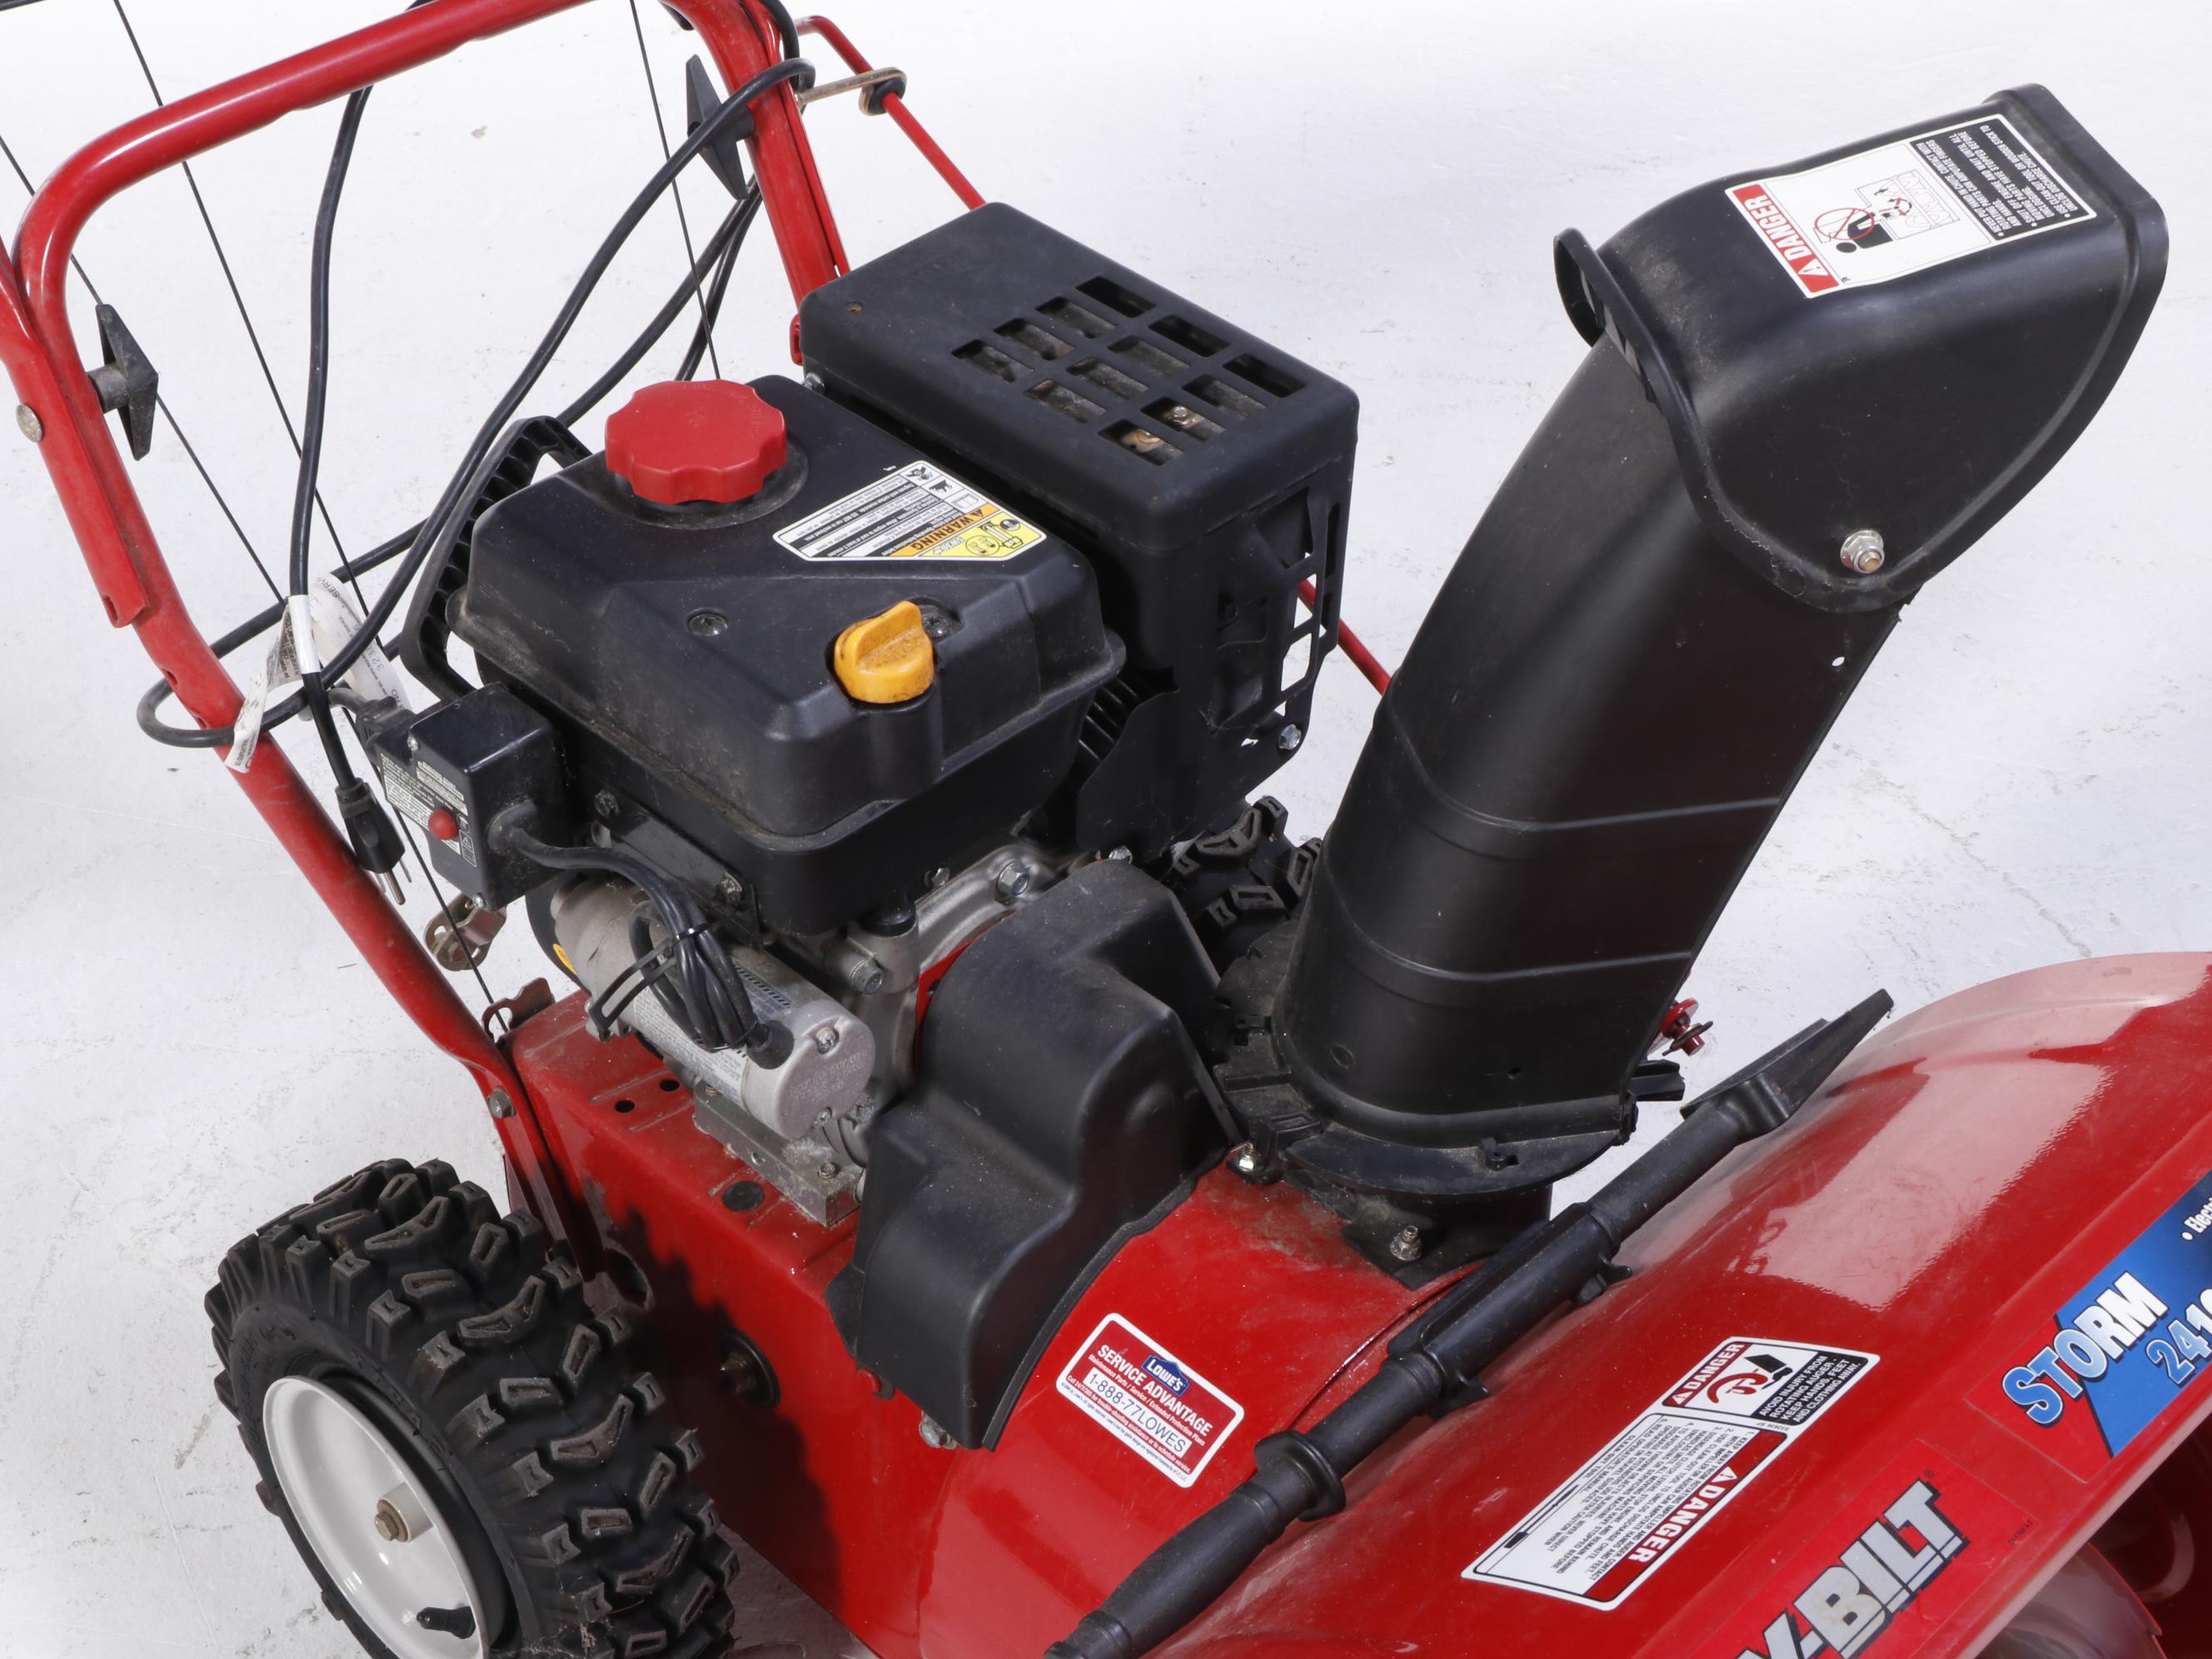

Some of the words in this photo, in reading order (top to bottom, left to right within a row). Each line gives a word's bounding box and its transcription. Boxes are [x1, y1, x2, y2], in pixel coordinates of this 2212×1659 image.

[1977, 124, 1992, 132] TO
[1946, 132, 1963, 143] ALL
[1955, 131, 1980, 150] BEFORE
[1984, 131, 2005, 145] STICK
[1914, 142, 1933, 155] WITH
[1923, 139, 1949, 159] FINGERS
[1955, 142, 1975, 157] UNTIL
[1995, 143, 2021, 163] WOODEN
[1925, 153, 1950, 174] CONTACT
[1968, 157, 1988, 171] WAIT
[1972, 148, 2000, 172] STOPPED
[2012, 161, 2028, 170] OR
[1940, 157, 1970, 182] AMPUTATE
[1980, 169, 1997, 181] AND
[1992, 169, 2013, 184] HAVE
[2020, 168, 2038, 181] TOOL
[1942, 172, 1964, 190] CHUTE.
[1961, 180, 1979, 192] CAN
[1989, 179, 2014, 199] ENGINE
[2030, 167, 2061, 193] DISCHARGE
[1961, 193, 1981, 208] HAND
[1970, 190, 1992, 207] PARTS
[2005, 182, 2028, 201] PARTS
[1989, 197, 2013, 217] HANDS.
[2005, 197, 2024, 209] OFF
[2019, 198, 2046, 220] MOVING
[2052, 203, 2069, 214] USE
[2053, 192, 2079, 212] UNCLOG
[1973, 207, 1990, 217] PUT
[1984, 205, 2014, 230] ROTATING
[2005, 215, 2023, 227] AND
[2015, 207, 2036, 223] SHUT
[1742, 194, 1813, 261] DANGER
[1981, 216, 2003, 232] NEVER
[909, 516, 974, 551] WARNING
[2002, 1271, 2169, 1427] STORM
[1145, 1358, 1184, 1392] LOWE'S
[1681, 1343, 1745, 1389] DANGER
[1096, 1343, 1147, 1387] SERVICE
[1142, 1378, 1213, 1437] ADVANTAGE
[1756, 1396, 1785, 1416] AVOID
[1777, 1373, 1809, 1396] INJURY
[1801, 1355, 1829, 1373] FROM
[1767, 1385, 1810, 1417] ROTATING
[1802, 1362, 1835, 1384] AUGER
[1779, 1401, 1806, 1419] KEEP
[1798, 1376, 1833, 1401] HANDS,
[1826, 1359, 1851, 1376] FEET
[1790, 1408, 1812, 1422] AND
[1803, 1379, 1843, 1408] CLOTHING
[1835, 1362, 1861, 1379] AWAY.
[1087, 1353, 1117, 1378] Maintenance
[1114, 1373, 1128, 1387] Parts
[1128, 1385, 1148, 1402] Service
[1148, 1399, 1171, 1419] Extended
[1168, 1415, 1193, 1437] Protection
[1191, 1432, 1206, 1446] Plans
[1088, 1372, 1187, 1452] 1-888-77LOWES
[1642, 1423, 1662, 1437] READ
[1712, 1433, 1729, 1442] USE
[1721, 1436, 1740, 1447] WITH
[1730, 1437, 1749, 1449] KEEP
[1697, 1447, 1726, 1469] IMPELLER
[1714, 1450, 1734, 1464] AWAY
[1654, 1465, 1669, 1475] ALL
[1667, 1472, 1686, 1484] TOOL
[1697, 1465, 1718, 1479] FROM
[1621, 1468, 1656, 1495] SERVICING
[1632, 1475, 1658, 1495] MOVING
[1671, 1477, 1694, 1493] AUGER
[1630, 1493, 1649, 1506] STOP
[1659, 1493, 1676, 1504] CAN
[1670, 1480, 1702, 1504] ROTATING
[1613, 1495, 1637, 1511] PARTS
[1598, 1512, 1618, 1525] HAVE
[1627, 1484, 1726, 1562] DANGER
[1632, 1505, 1664, 1530] AMPUTATE
[1642, 1505, 1675, 1529] IMPELLER
[1565, 1520, 1586, 1534] NEVER
[1597, 1524, 1614, 1535] AND
[1604, 1512, 1642, 1542] DISCHARGE
[1631, 1530, 1647, 1541] AND
[1572, 1526, 1602, 1548] STOPPED
[1575, 1536, 1602, 1555] REMAIN
[1612, 1531, 1636, 1548] HANDS
[1550, 1548, 1577, 1568] BEFORE
[1599, 1548, 1617, 1559] AND
[1555, 1555, 1580, 1574] BEHIND
[1584, 1559, 1604, 1573] FEET.
[1587, 1558, 1617, 1581] CONTACT
